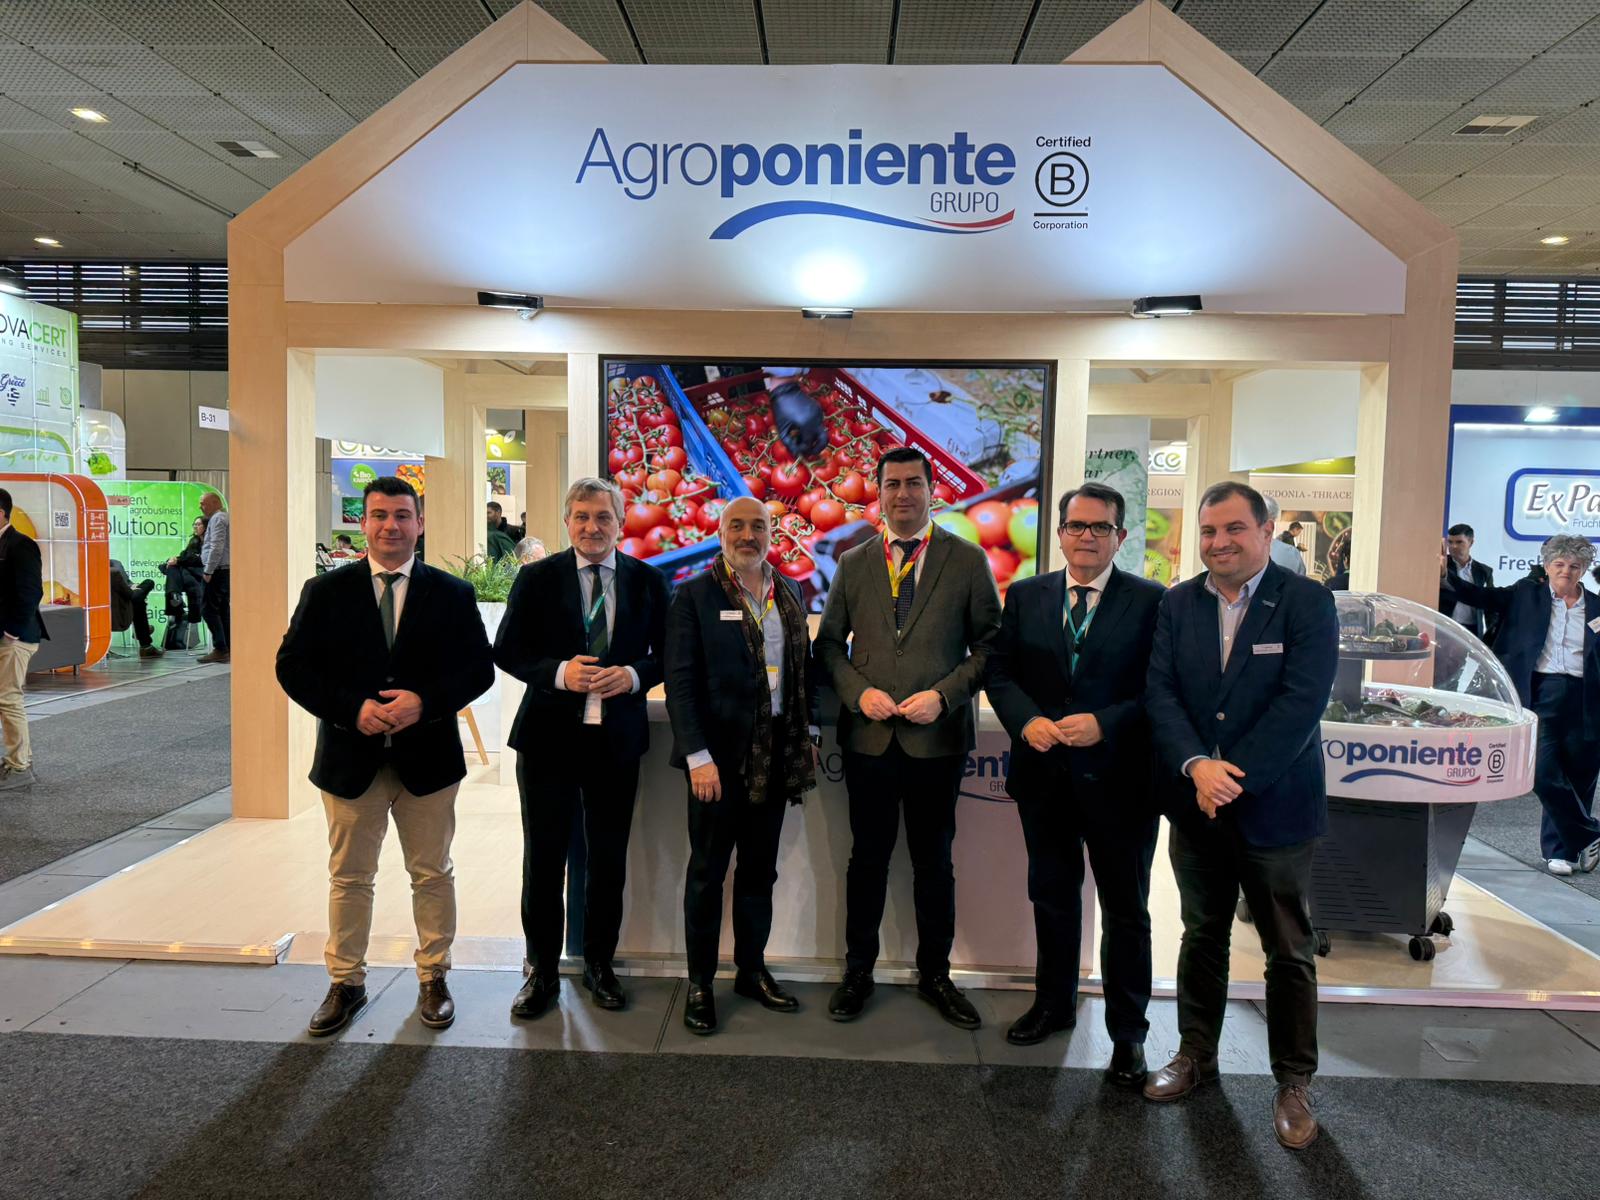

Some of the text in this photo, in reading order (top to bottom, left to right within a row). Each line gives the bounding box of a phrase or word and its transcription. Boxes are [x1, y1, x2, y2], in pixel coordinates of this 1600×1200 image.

[1036, 136, 1092, 147] Certified
[575, 127, 1016, 200] Agroponiente
[1050, 163, 1075, 195] B
[930, 191, 1000, 213] GRUPO
[1033, 220, 1088, 230] Corporation
[20, 342, 67, 358] SERVICES
[201, 412, 216, 423] B-31
[1088, 448, 1136, 461] rtner,
[1312, 490, 1352, 499] THRACE
[130, 506, 183, 516] agrobusiness
[1493, 754, 1501, 769] B
[1446, 767, 1476, 778] GRUPO
